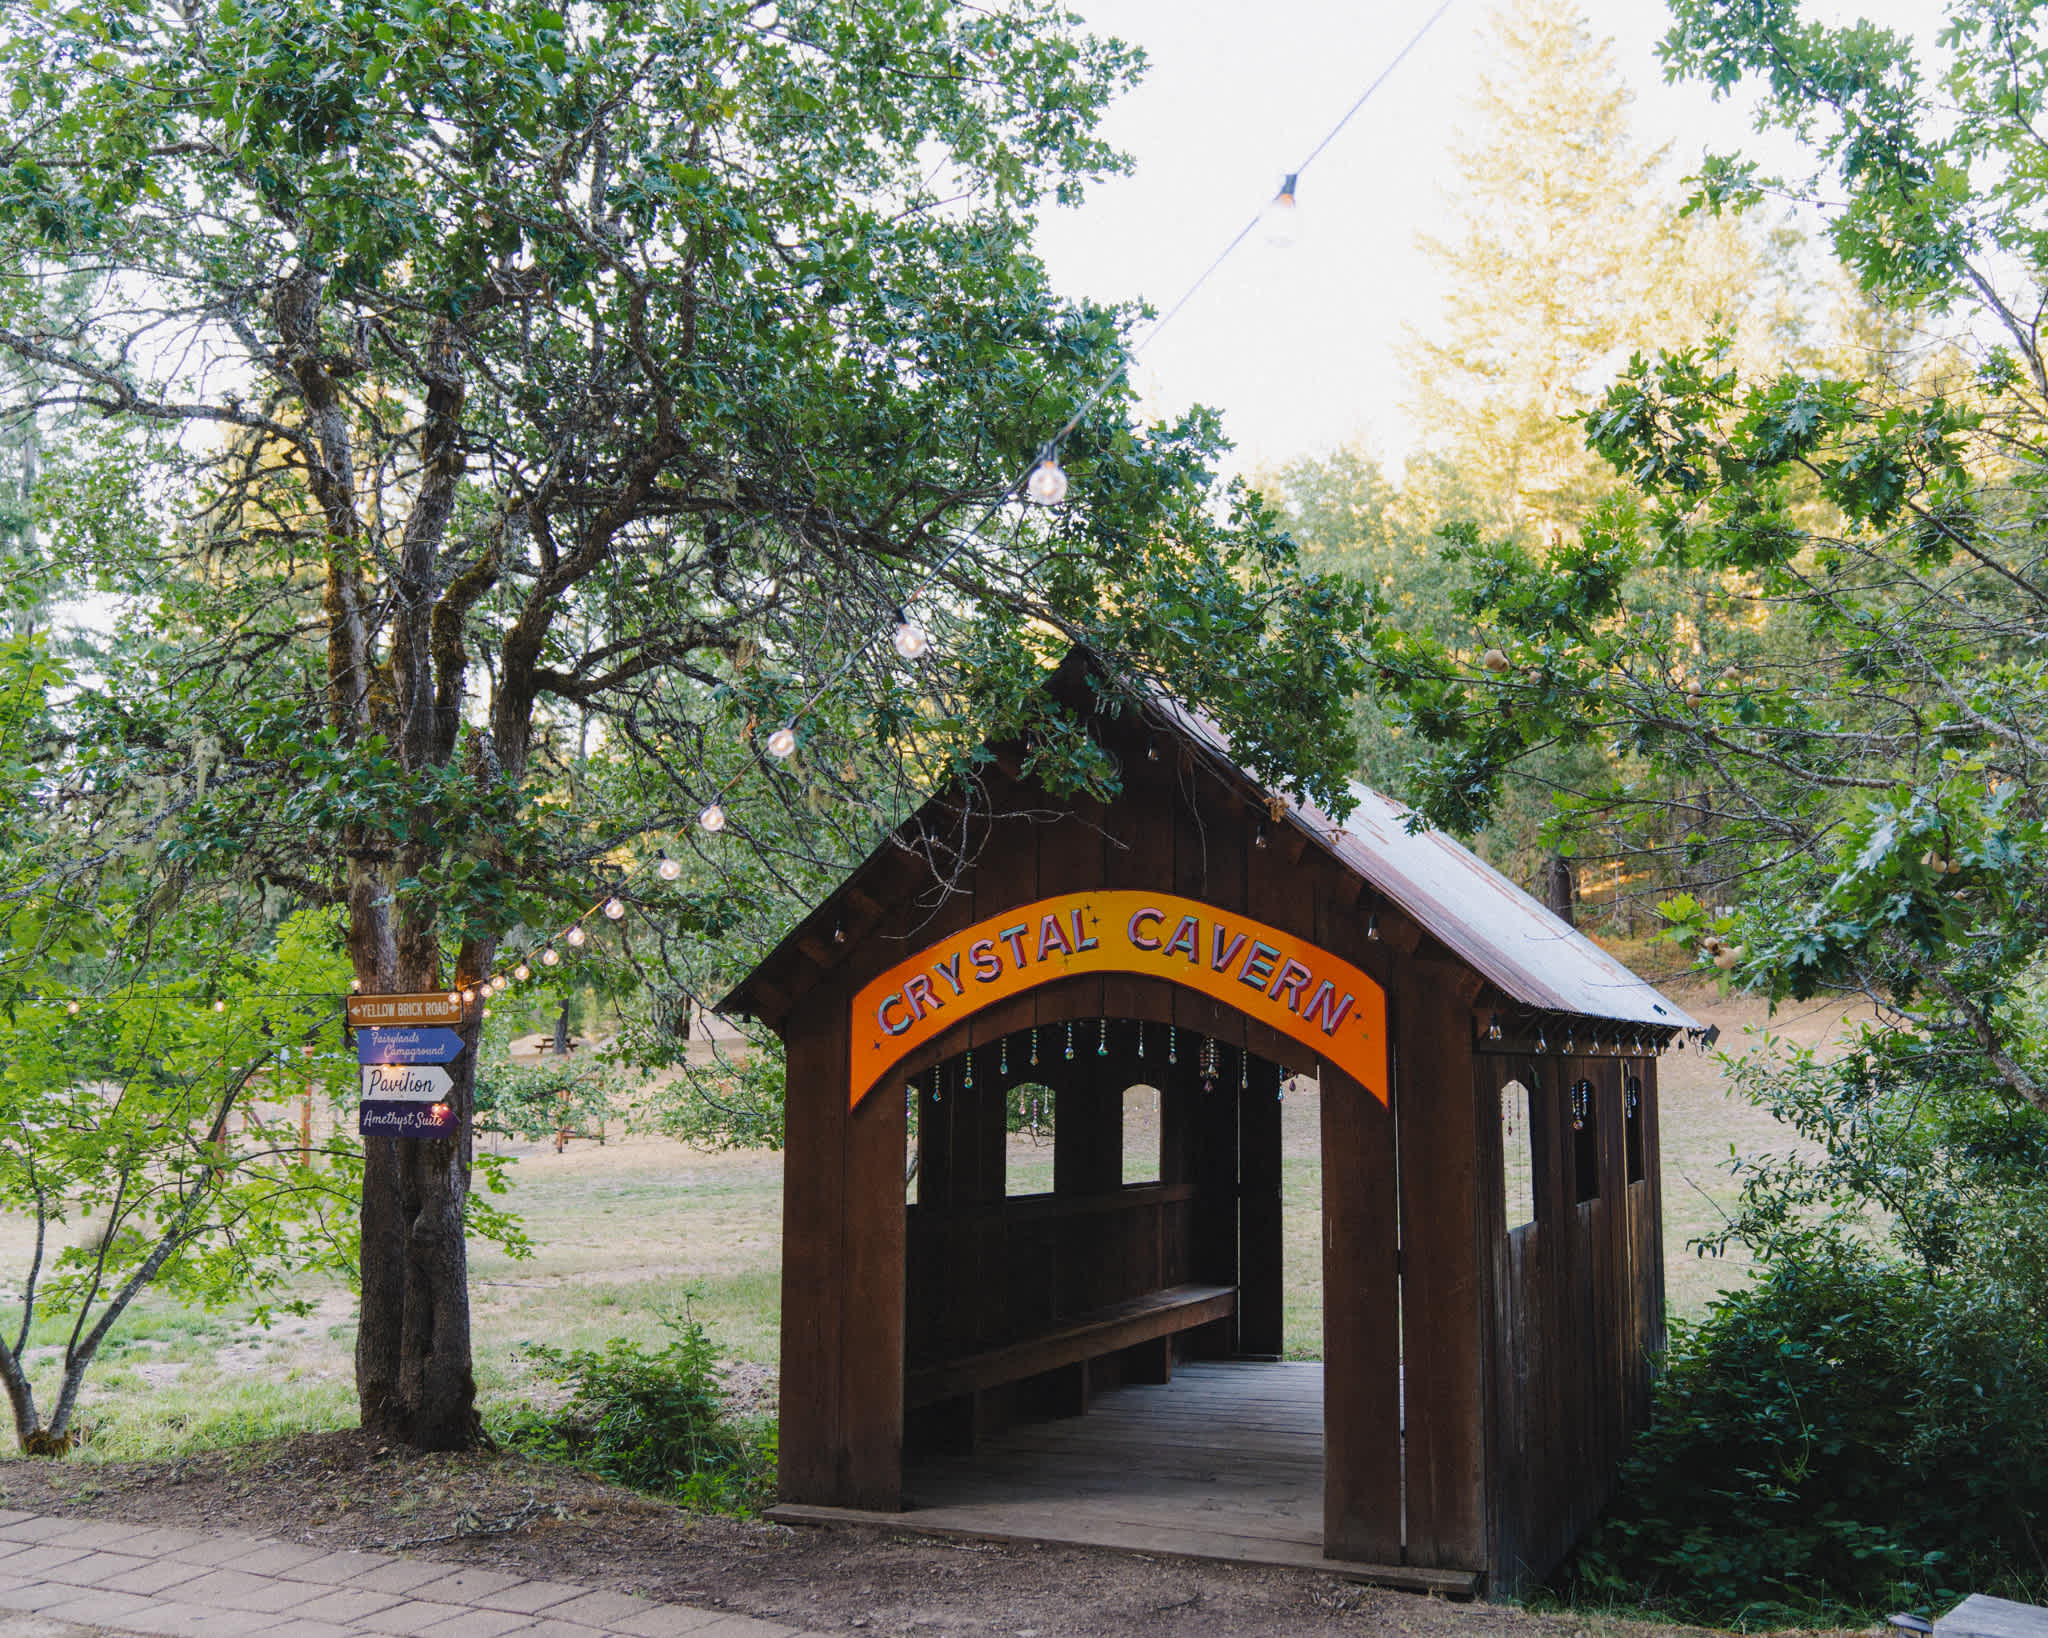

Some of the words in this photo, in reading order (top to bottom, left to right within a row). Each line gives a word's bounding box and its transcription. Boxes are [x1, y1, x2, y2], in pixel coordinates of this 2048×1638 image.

[878, 909, 1099, 1035] CRYSTAL
[1127, 908, 1355, 1037] CAVERN
[361, 1004, 394, 1017] YELLOW
[397, 1002, 423, 1017] BRICK
[425, 1002, 448, 1016] ROAD
[384, 1045, 445, 1061] Campground
[368, 1069, 435, 1096] Pavilion
[363, 1110, 414, 1131] Amethyst
[415, 1111, 445, 1128] Suite
